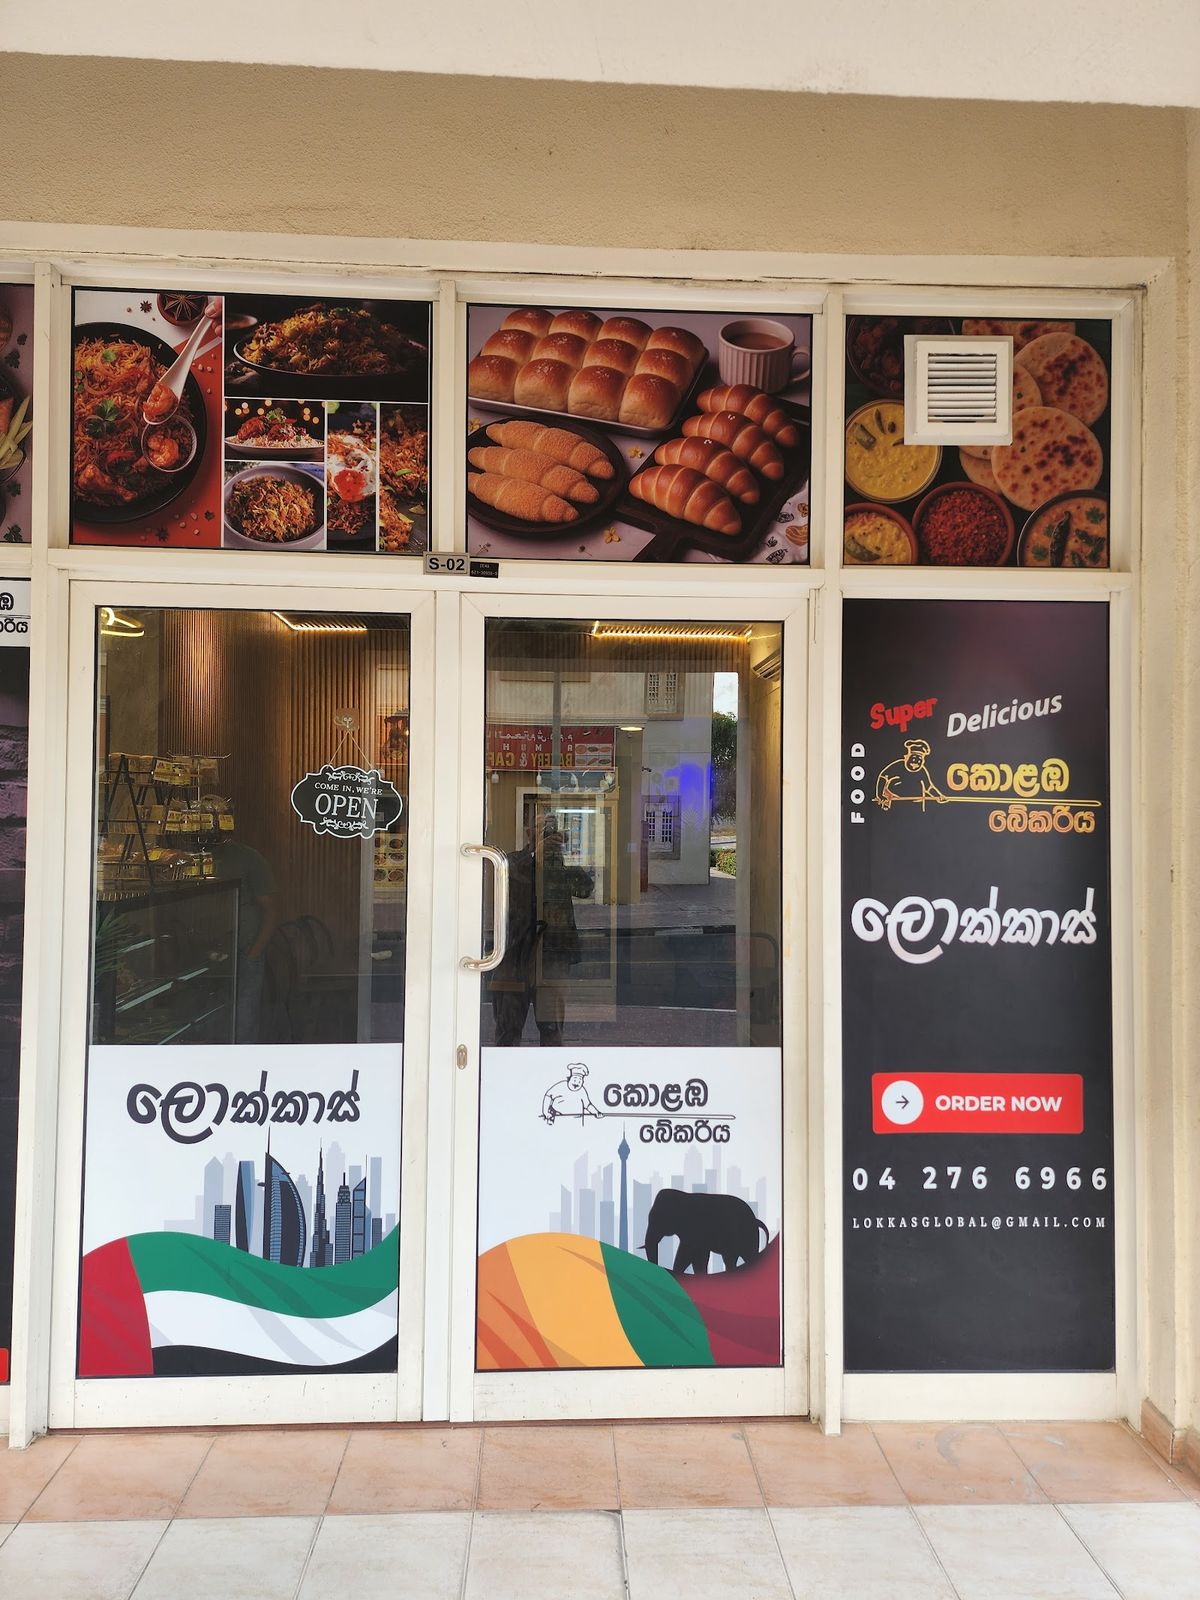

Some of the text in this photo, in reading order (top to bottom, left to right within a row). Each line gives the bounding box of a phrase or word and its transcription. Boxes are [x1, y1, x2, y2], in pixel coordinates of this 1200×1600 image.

[429, 558, 465, 571] S-02
[870, 698, 937, 732] Super
[947, 695, 1062, 737] Delicious
[314, 782, 339, 791] COME
[356, 786, 383, 796] WE'RE
[850, 742, 866, 824] FOOD
[946, 758, 1070, 798] කොළඹ
[315, 793, 378, 820] OPEN
[988, 804, 1096, 833] බේකරිය
[851, 885, 1097, 965] ලොක්කාස්
[126, 1069, 361, 1144] ලොක්කාස්
[603, 1078, 709, 1112] කොළඹ
[935, 1095, 1063, 1112] ORDER NOW
[639, 1119, 731, 1144] බේකරිය
[852, 1166, 1107, 1191] 04 276 6966
[852, 1216, 1105, 1230] LOKKASGLOBAL@GMAIL.COM
